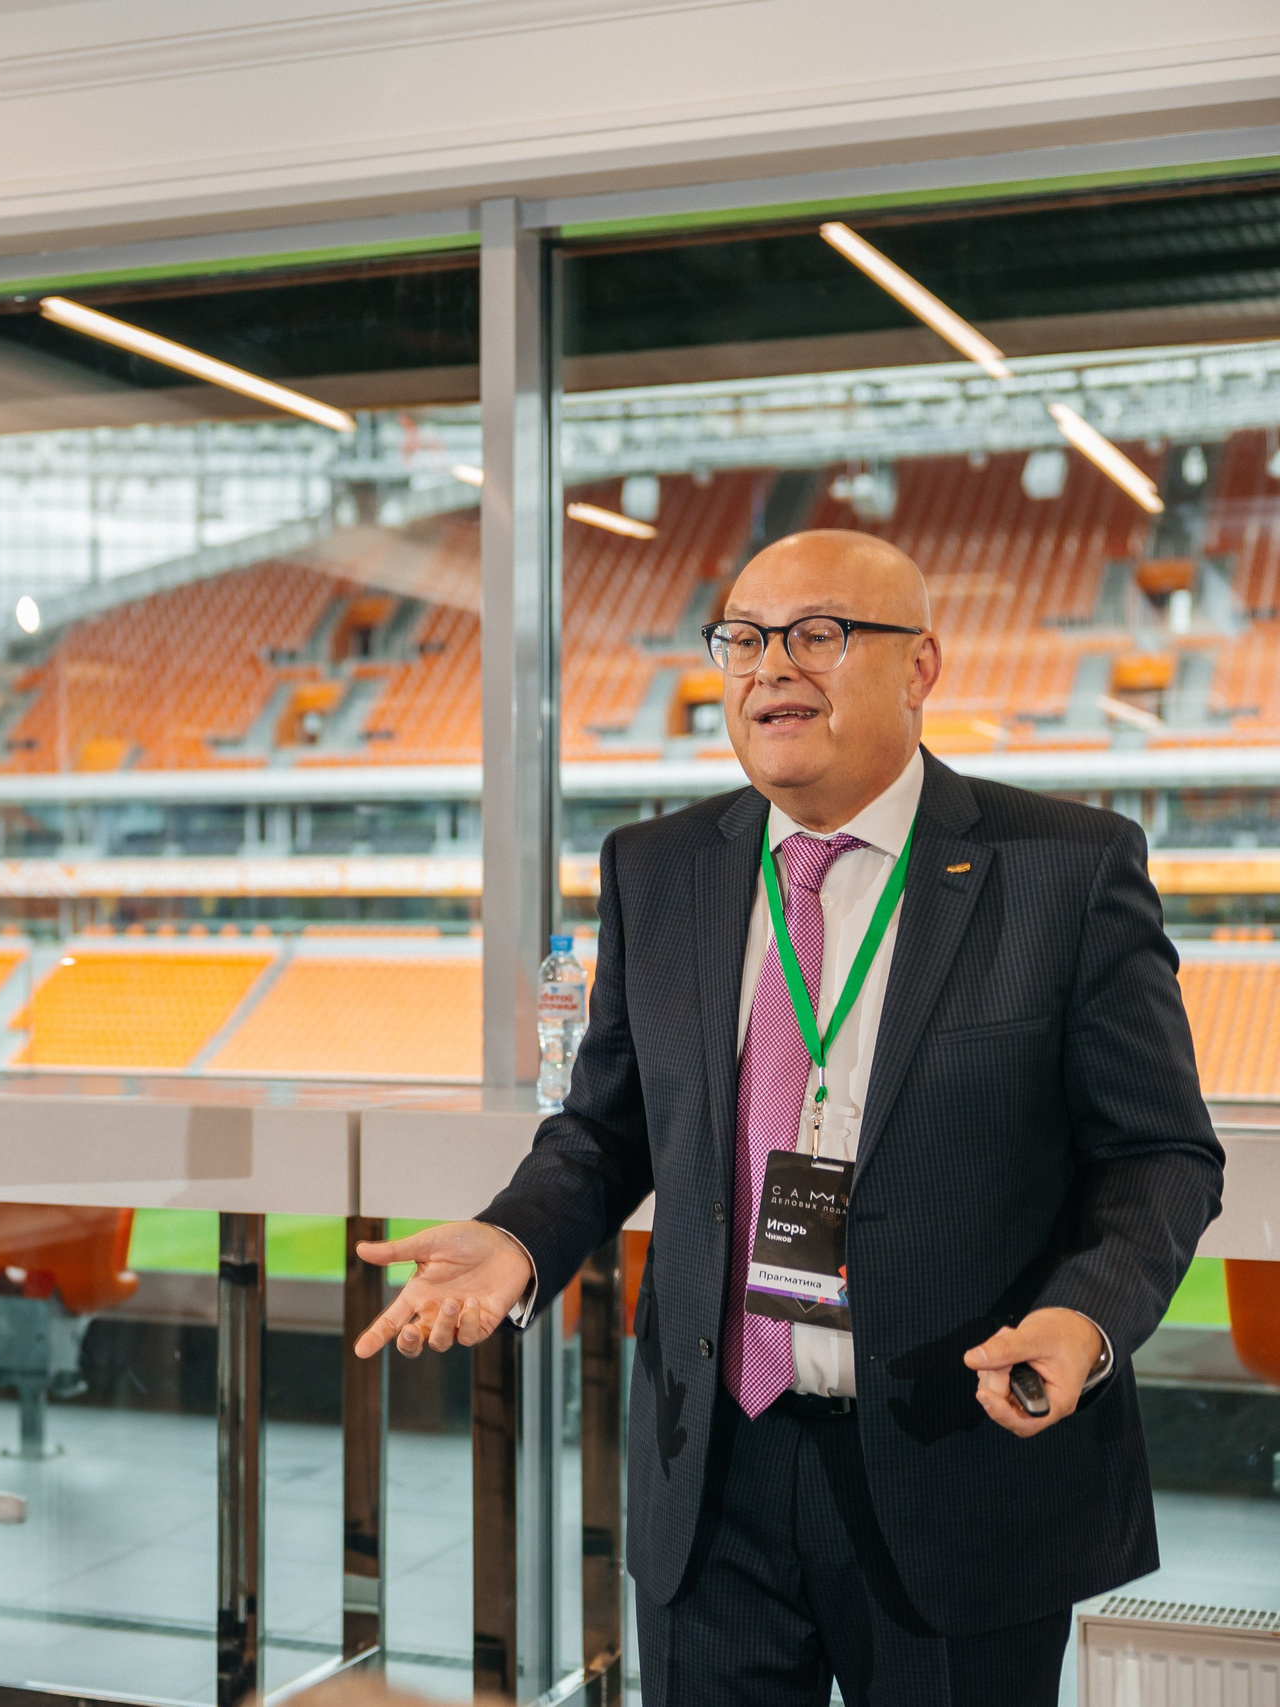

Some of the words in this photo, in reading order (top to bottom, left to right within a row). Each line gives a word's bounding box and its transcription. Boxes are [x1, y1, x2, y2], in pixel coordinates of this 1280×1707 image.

[770, 1196, 818, 1210] ДЕЛОВЫХ
[823, 1205, 847, 1215] ПОДА
[767, 1217, 807, 1236] Игорь
[765, 1231, 792, 1243] Чижов
[759, 1270, 822, 1289] Прагматика
